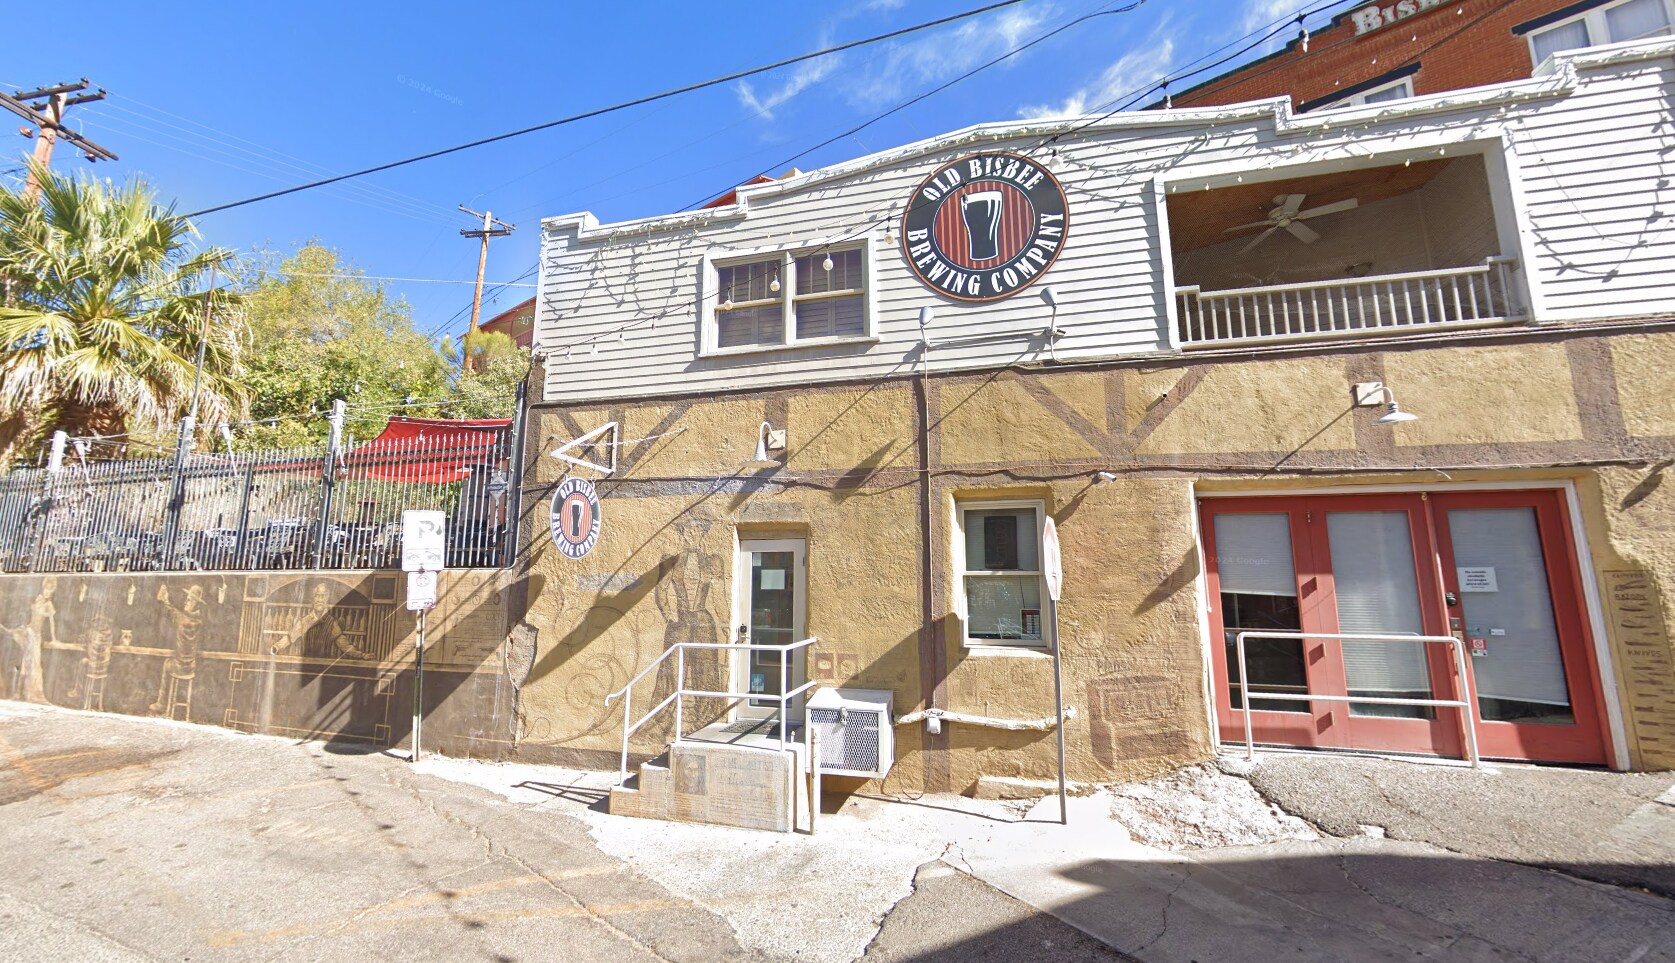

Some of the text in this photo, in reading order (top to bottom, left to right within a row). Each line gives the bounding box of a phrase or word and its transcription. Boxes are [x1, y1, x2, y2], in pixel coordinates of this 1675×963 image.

[922, 157, 1045, 201] OLD BISBEE
[907, 213, 1064, 296] BREWING COMPANY
[560, 480, 597, 506] OLD BISBEE
[552, 512, 600, 556] BREWING COMPANY
[1627, 649, 1663, 658] KNIVES
